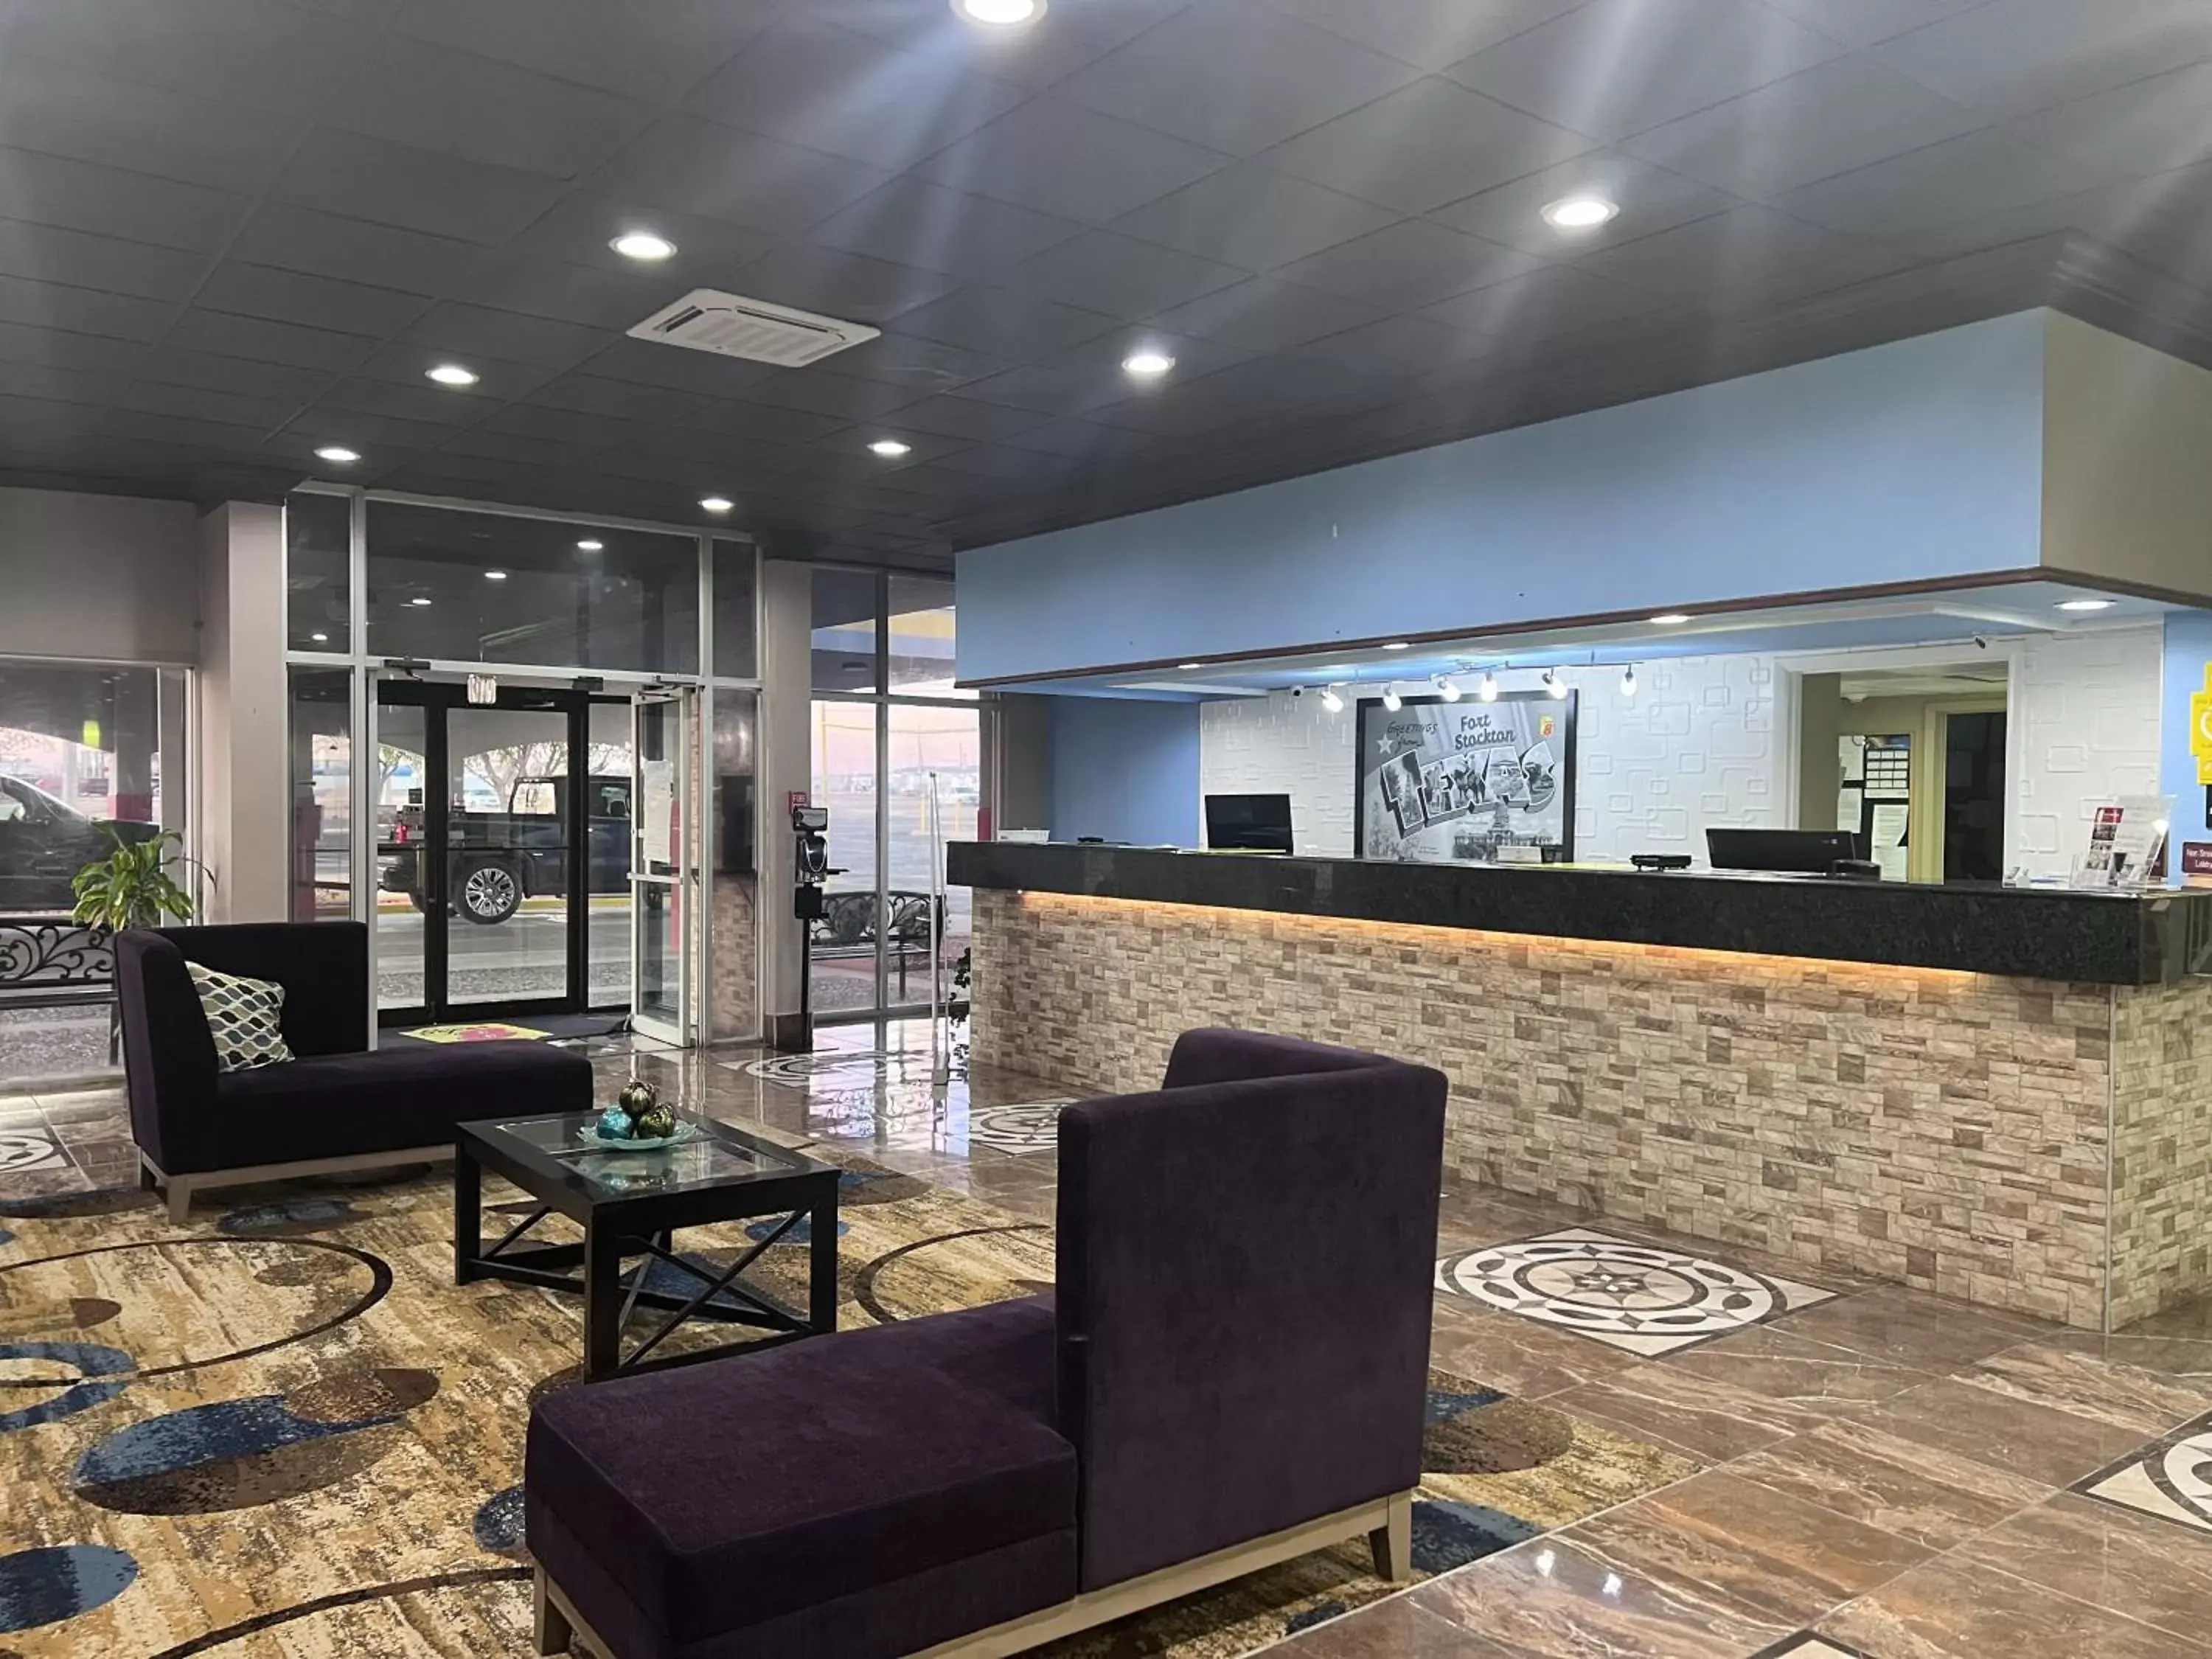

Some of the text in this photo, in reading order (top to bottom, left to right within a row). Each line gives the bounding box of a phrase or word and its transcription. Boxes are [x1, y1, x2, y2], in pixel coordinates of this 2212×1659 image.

[1460, 714, 1492, 731] Fort
[1454, 727, 1517, 751] Stockton
[1380, 740, 1556, 839] TEXAS
